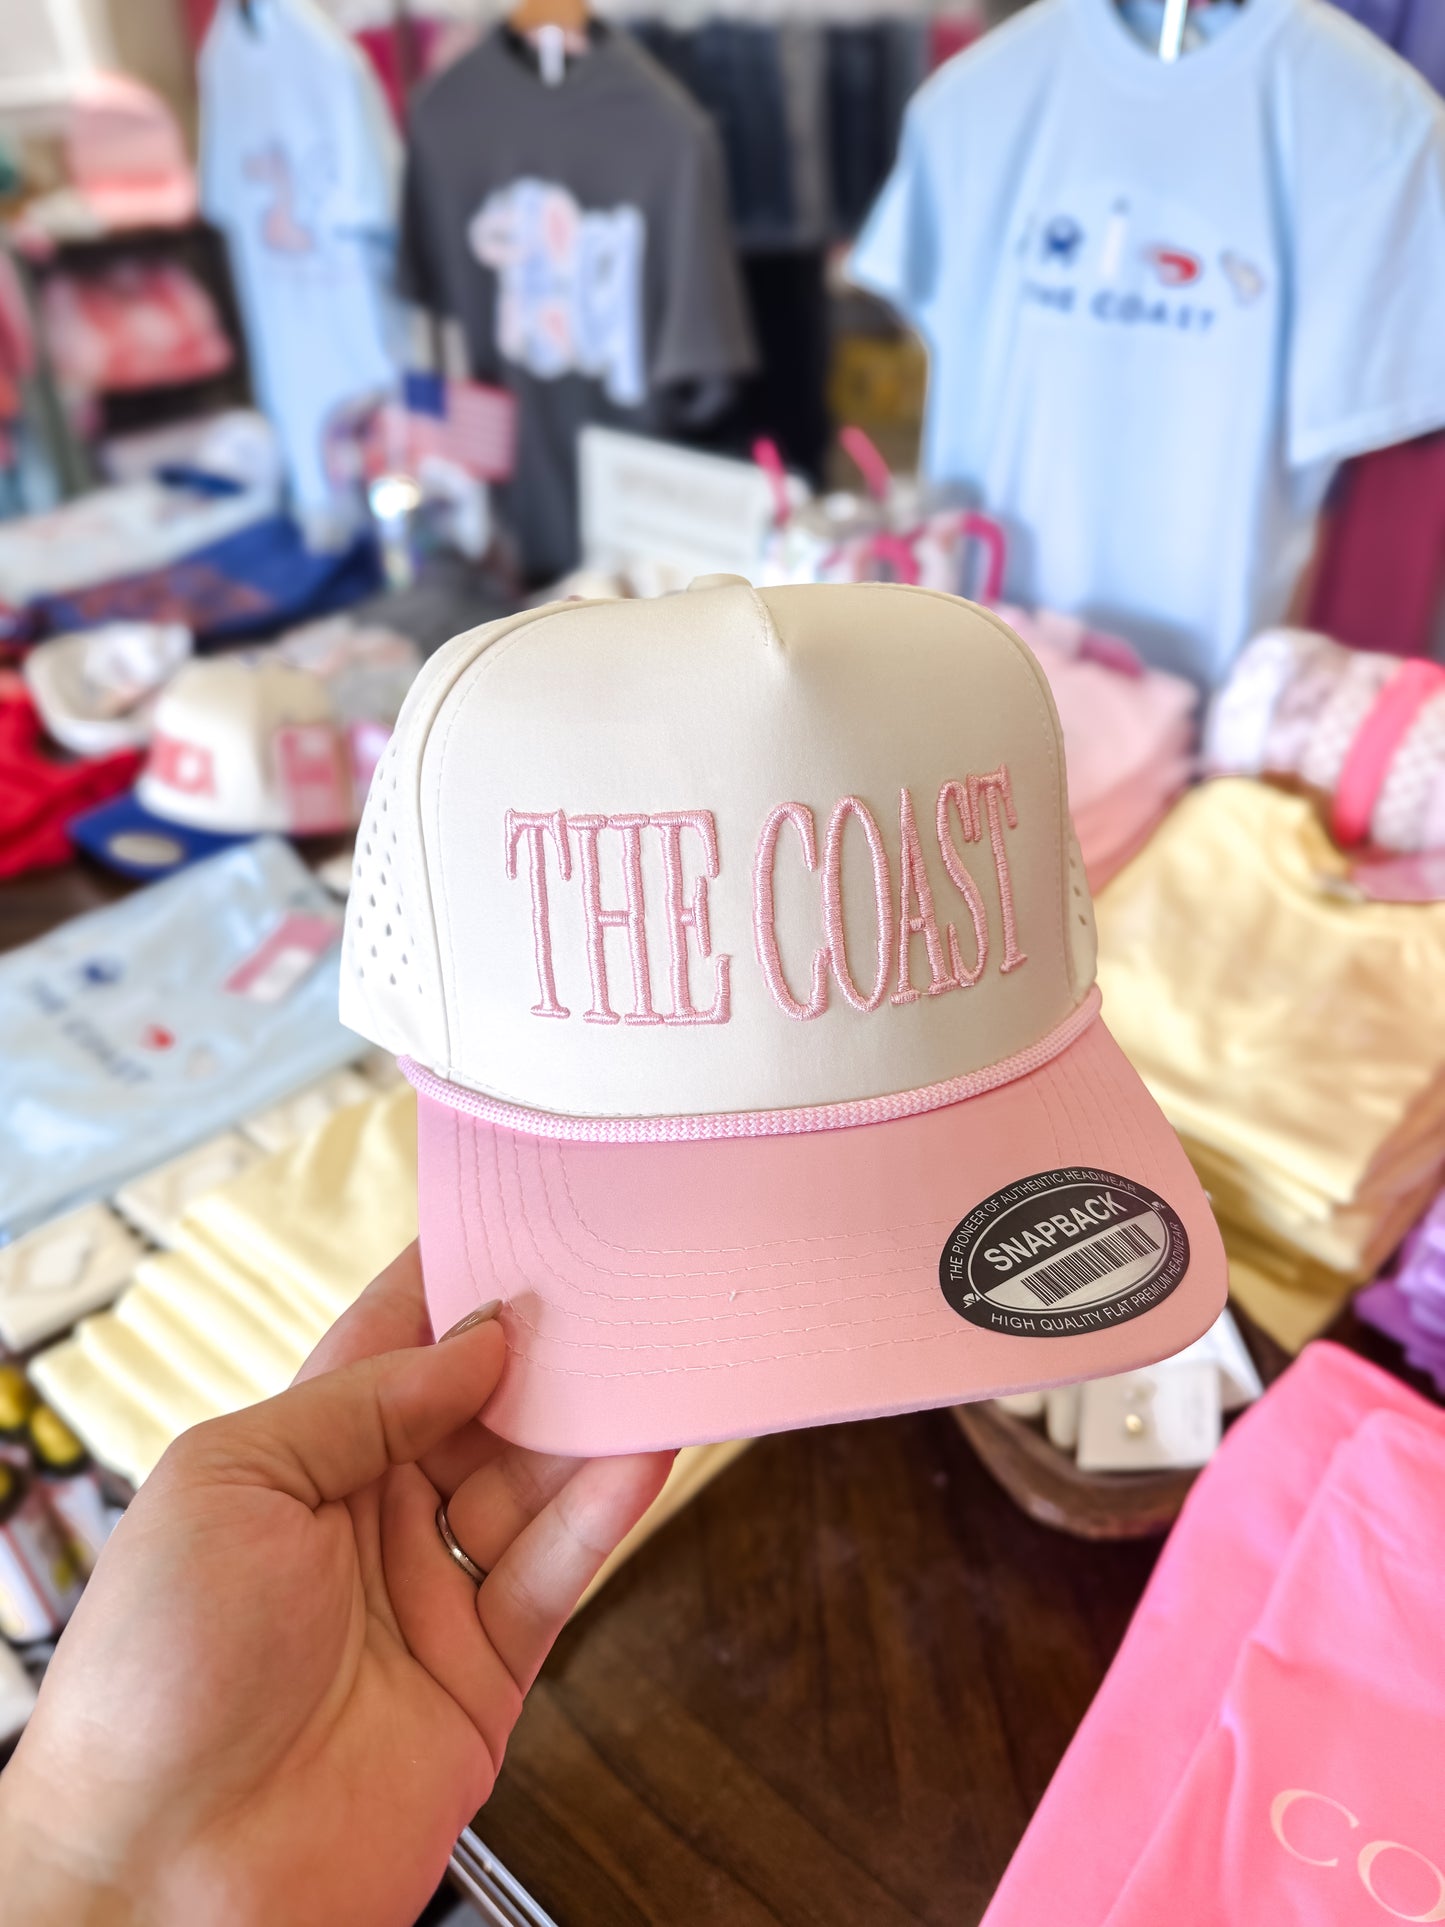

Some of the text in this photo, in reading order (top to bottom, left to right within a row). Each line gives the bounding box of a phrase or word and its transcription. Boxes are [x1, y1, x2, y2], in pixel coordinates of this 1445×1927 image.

[504, 763, 1027, 1025] THE COAST
[950, 1170, 1137, 1281] THE PIONEER OF AUTHENTIC HEADWEAR
[983, 1191, 1128, 1272] SNAPBACK
[991, 1221, 1187, 1331] HIGH QUALITY FLAT PREMIUM HEADWEAR
